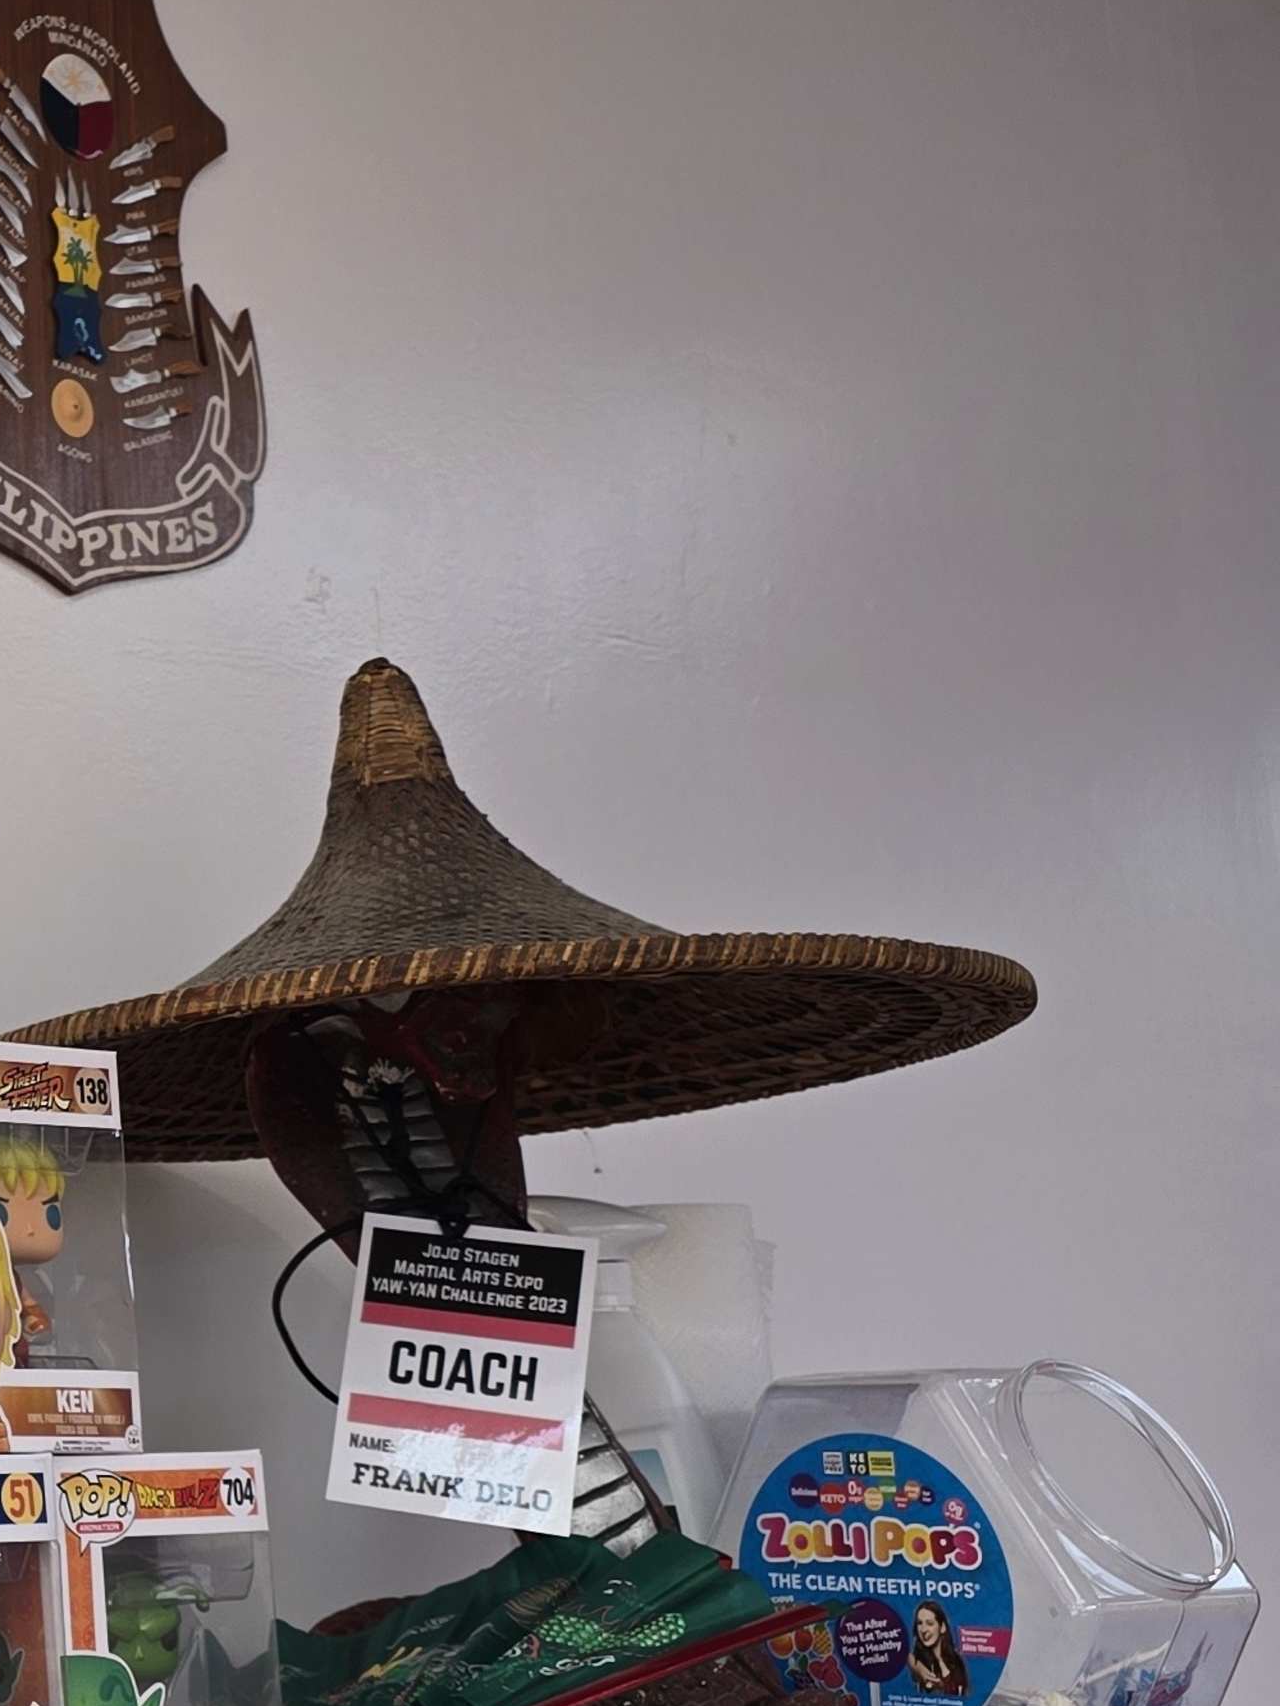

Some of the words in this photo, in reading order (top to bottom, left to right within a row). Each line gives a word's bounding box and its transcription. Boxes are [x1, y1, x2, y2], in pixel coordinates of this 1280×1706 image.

[14, 15, 67, 41] WEAPONS
[76, 1077, 109, 1105] 138
[422, 1243, 459, 1262] JOJO
[463, 1247, 520, 1268] STAGEN
[393, 1259, 457, 1282] MARTIAL
[461, 1267, 500, 1287] ARTS
[504, 1272, 544, 1291] EXPO
[372, 1276, 437, 1300] YAW-YAN
[441, 1285, 525, 1310] CHALLENGE
[529, 1295, 567, 1314] 2023
[388, 1339, 539, 1402] COACH
[56, 1389, 94, 1414] KEN
[9, 1479, 35, 1518] 51
[56, 1473, 133, 1522] POP!
[223, 1477, 254, 1506] 704
[351, 1461, 463, 1499] FRANK
[476, 1478, 552, 1512] DELO
[820, 1494, 846, 1504] KETO
[757, 1512, 870, 1565] ZOLLI
[870, 1516, 983, 1571] POPS
[768, 1572, 802, 1590] THE
[805, 1573, 863, 1593] CLEAN
[865, 1576, 921, 1597] TEETH
[840, 1634, 859, 1645] You
[860, 1631, 875, 1642] Eat
[845, 1622, 863, 1632] The
[864, 1618, 887, 1631] After
[842, 1644, 857, 1656] For
[858, 1646, 865, 1654] a
[866, 1640, 903, 1653] Healthy
